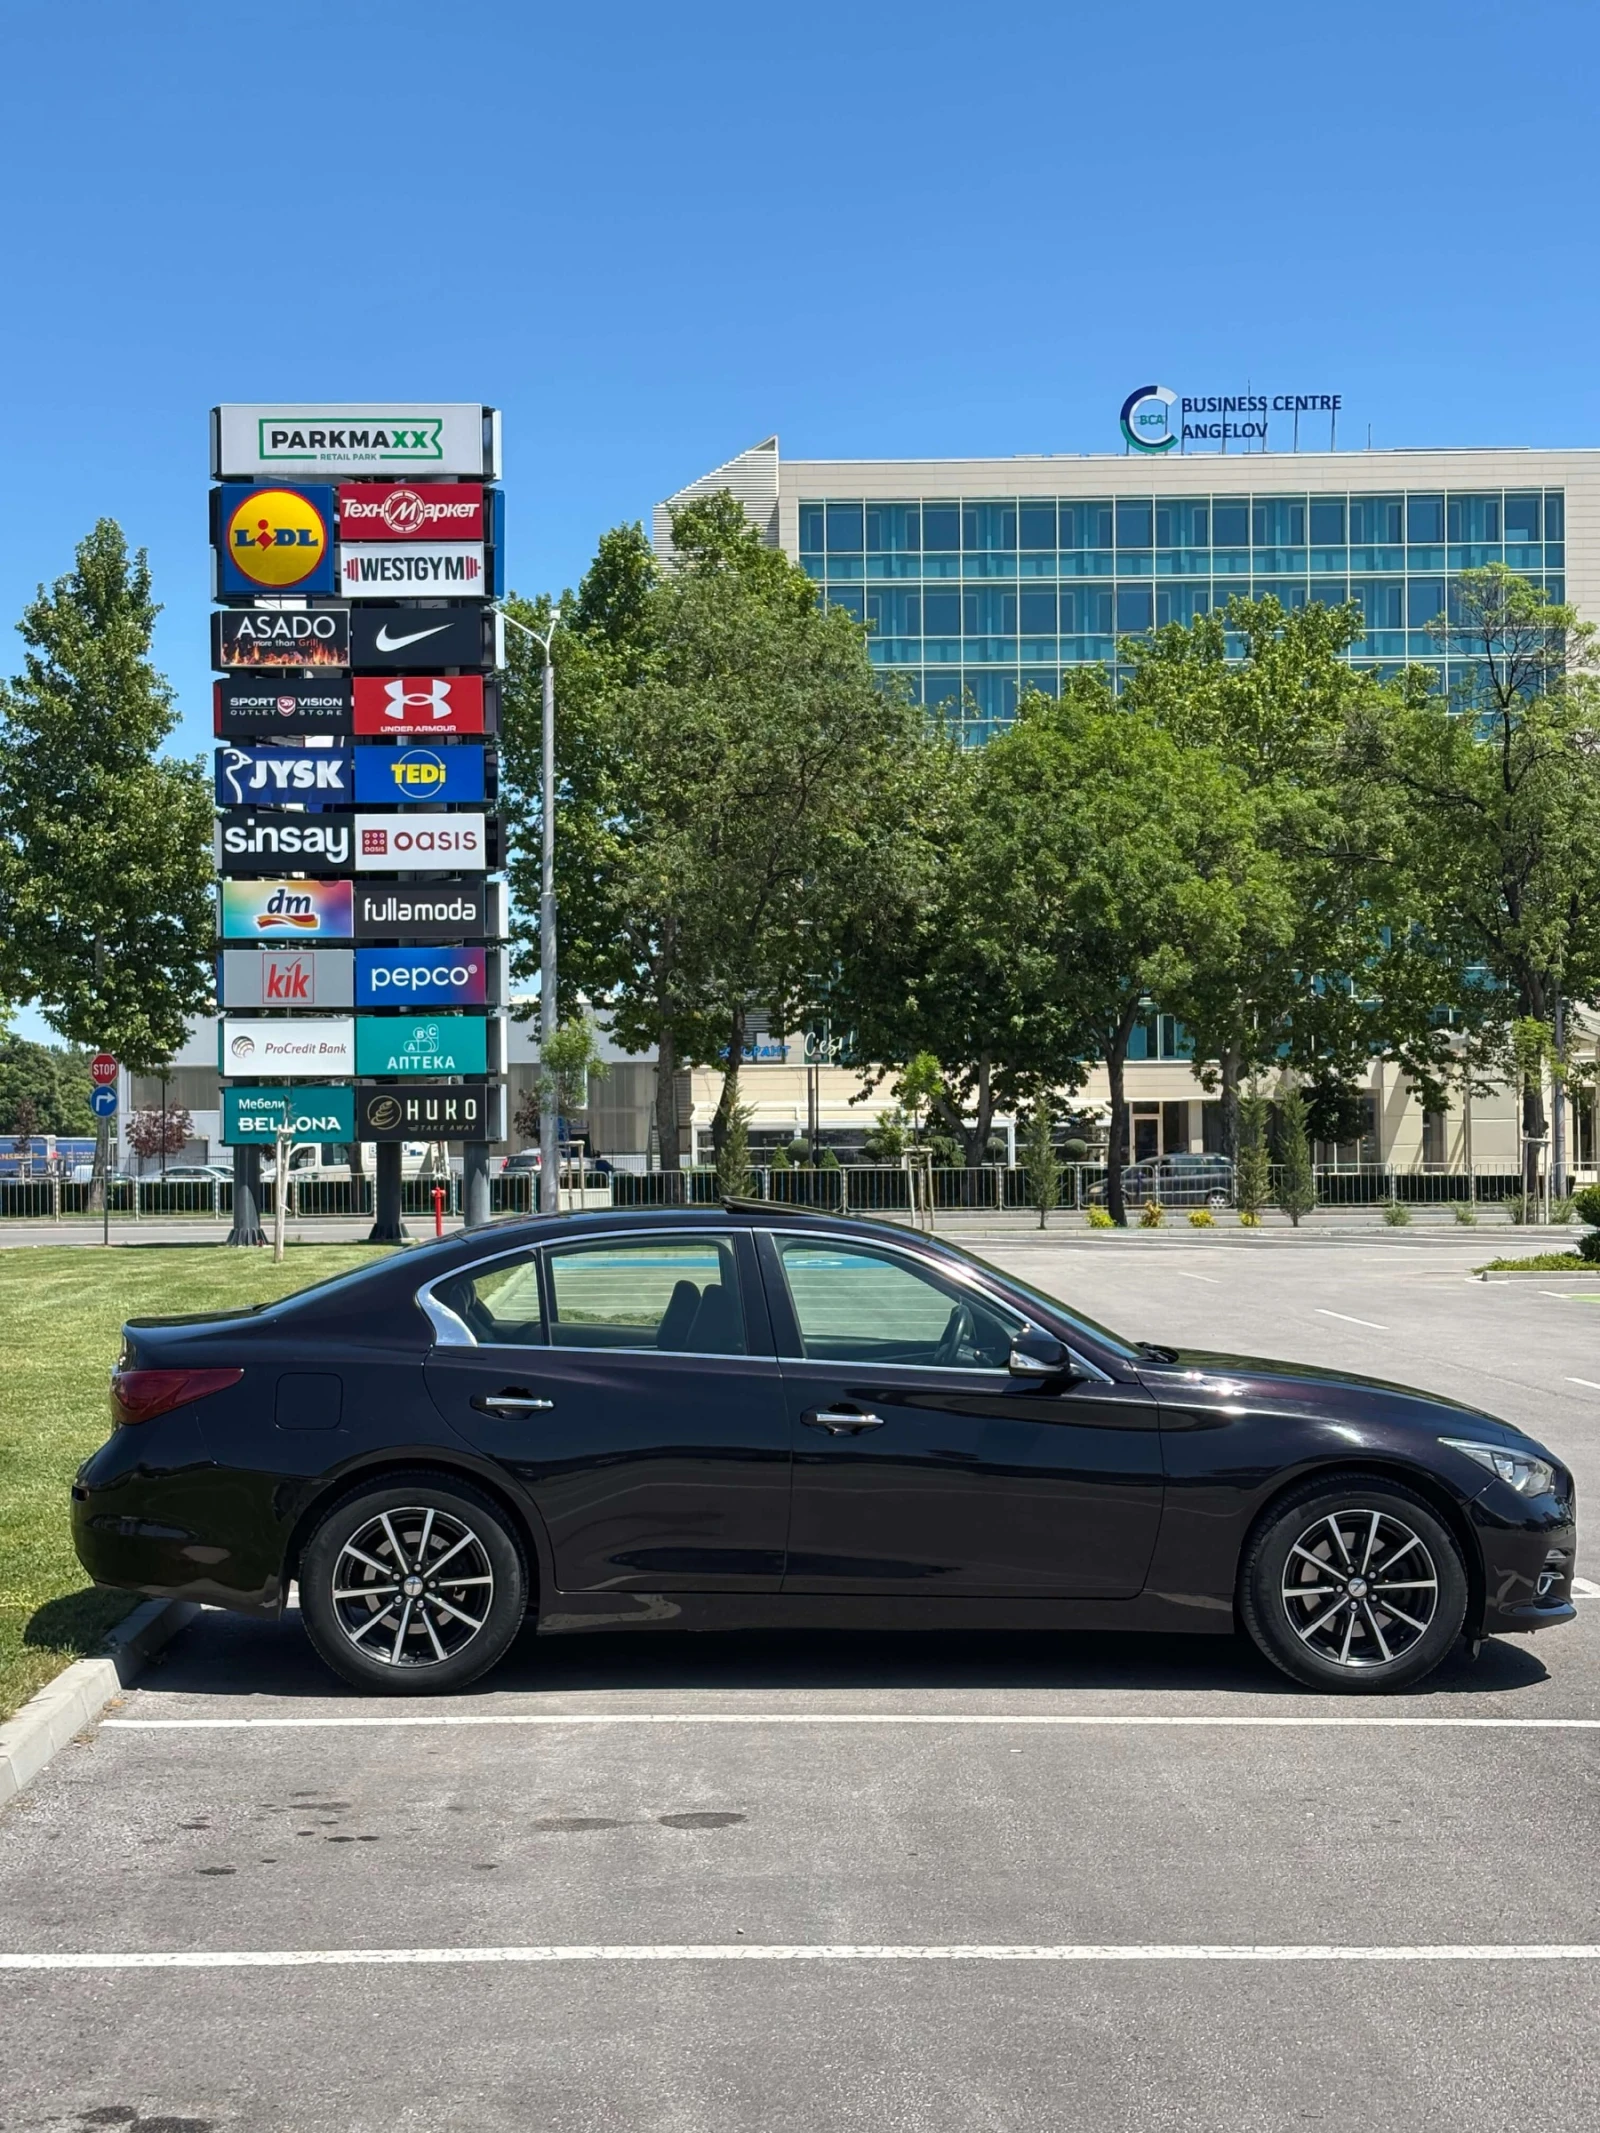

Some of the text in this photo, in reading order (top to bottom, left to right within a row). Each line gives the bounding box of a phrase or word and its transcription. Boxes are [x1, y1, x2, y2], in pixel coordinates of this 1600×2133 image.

[1182, 394, 1342, 413] BUSINESS CENTRE
[1139, 414, 1165, 426] BCA
[271, 430, 428, 449] PARKMAXX
[1181, 422, 1268, 440] ANGELOV
[320, 453, 377, 461] RETAIL PARK
[360, 556, 465, 582] WESTGYM
[236, 615, 336, 639] ASADO
[253, 638, 319, 648] more than Grill
[230, 697, 343, 707] SPORT VISION
[380, 725, 413, 733] UNDER
[249, 760, 345, 789] JYSK
[391, 764, 447, 784] TEDi
[224, 818, 349, 863] sinsay
[393, 831, 478, 851] oasis
[266, 888, 312, 914] dm
[364, 897, 477, 922] fullamoda
[371, 966, 469, 992] pepco
[265, 1042, 347, 1054] ProCredit Bank
[93, 1063, 116, 1076] STOP
[387, 1056, 456, 1070] АПТЕКА
[238, 1098, 286, 1109] Мебели
[406, 1098, 477, 1120] HUKO
